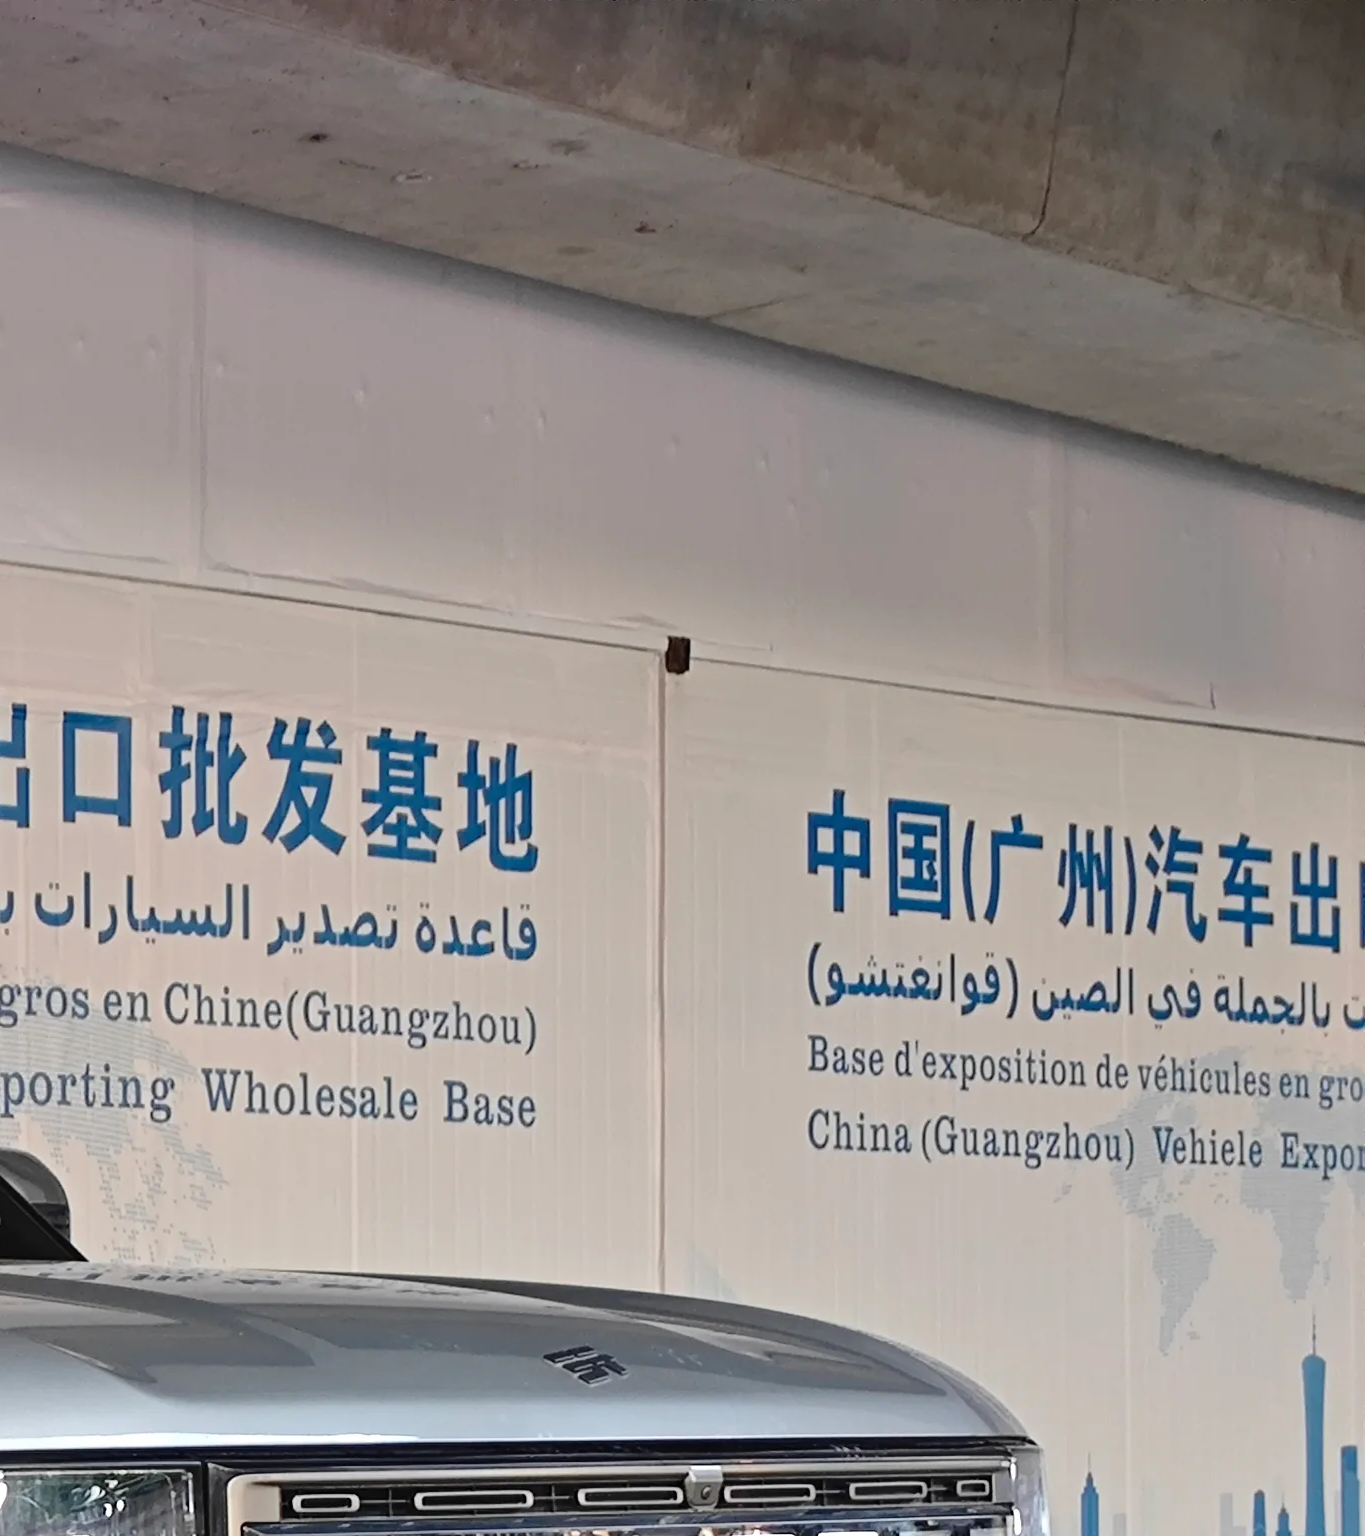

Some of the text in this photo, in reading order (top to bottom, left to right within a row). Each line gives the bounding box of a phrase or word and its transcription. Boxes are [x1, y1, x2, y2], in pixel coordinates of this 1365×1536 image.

[806, 788, 1365, 954] 中国(广州)汽车出
[33, 871, 252, 946] السيارات
[266, 902, 399, 957] تصدير
[414, 902, 538, 962] قاعدة
[104, 989, 152, 1023] en
[1032, 966, 1135, 1021] الصين
[1147, 967, 1202, 1030] في
[1214, 973, 1331, 1038] بالجملة
[202, 1066, 419, 1121] Wholesale
[443, 1079, 537, 1128] Base
[806, 1034, 885, 1078] Base
[894, 1040, 1087, 1092] d'exposition
[1095, 1051, 1130, 1090] de
[1137, 1053, 1271, 1097] véhicules
[1279, 1072, 1311, 1099] en
[806, 1107, 913, 1154] China
[921, 1115, 1136, 1170] (Guangzhou)
[1152, 1124, 1263, 1168] Vehiele
